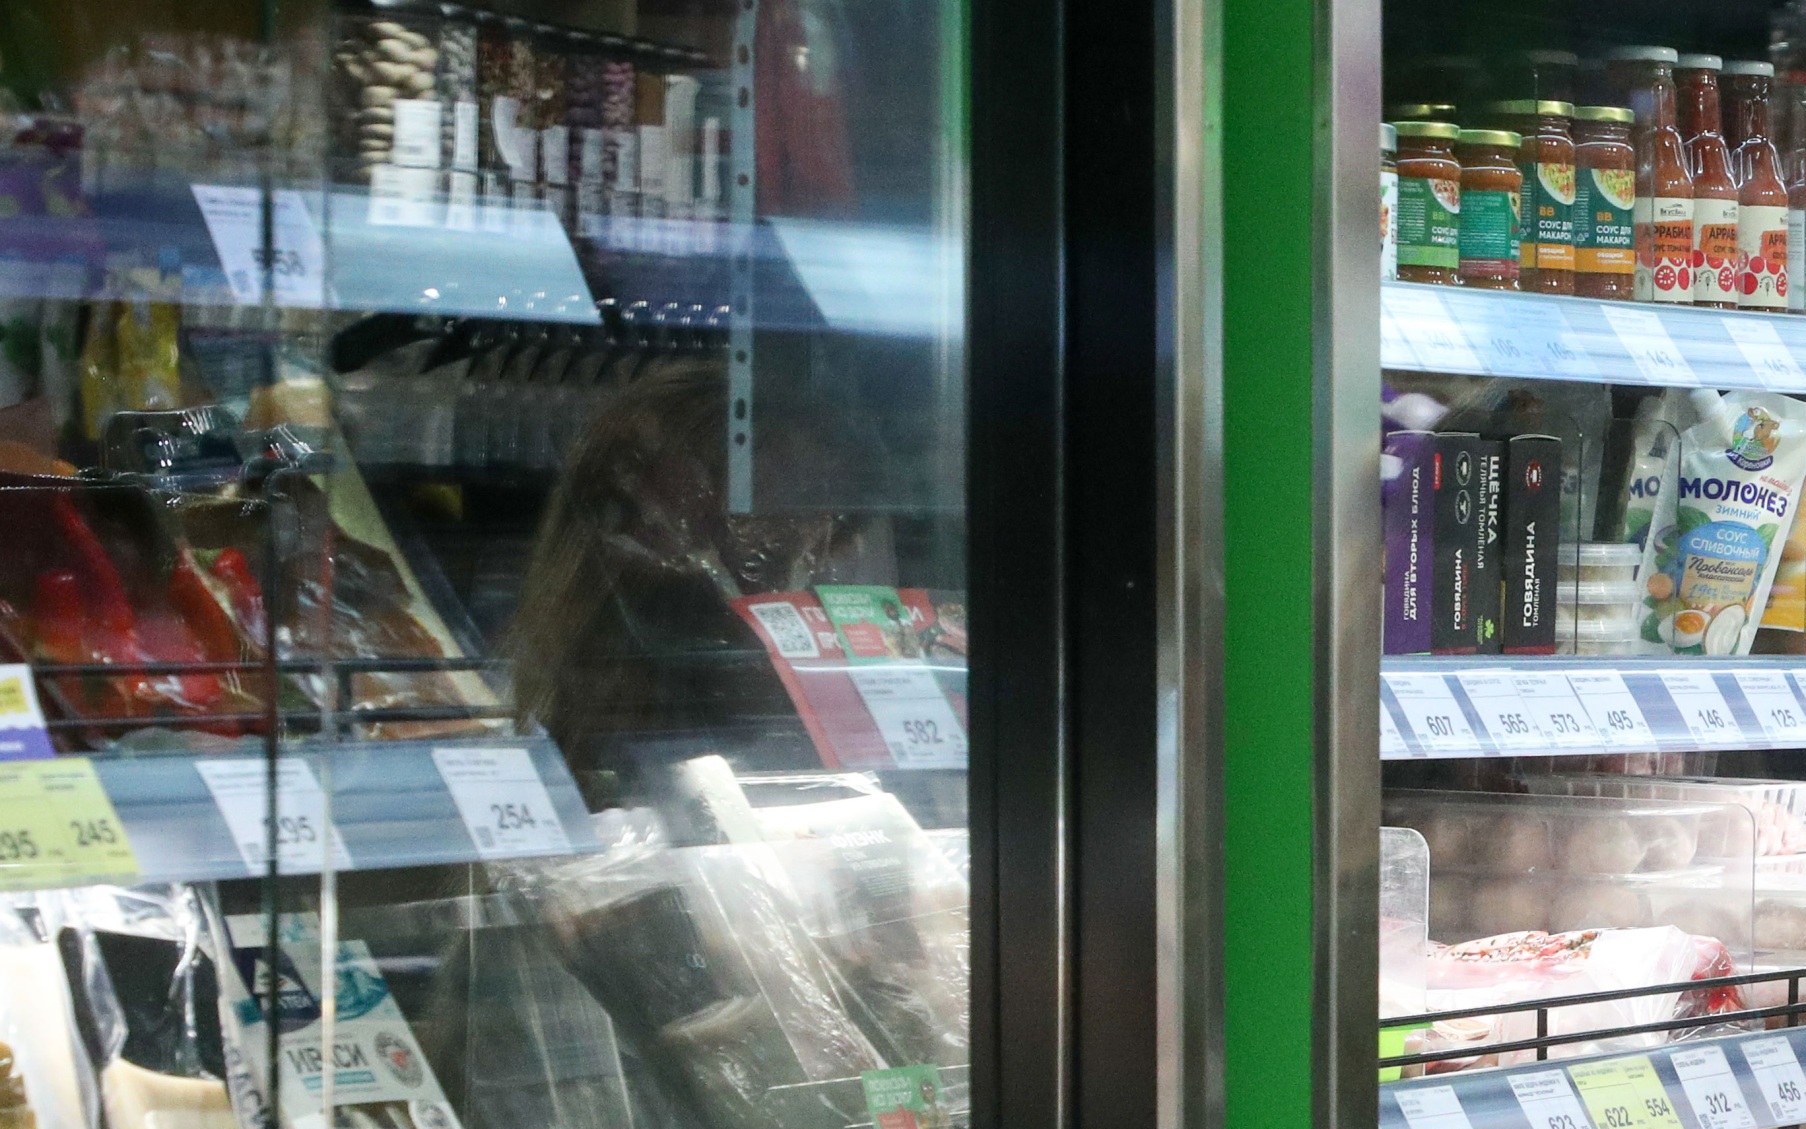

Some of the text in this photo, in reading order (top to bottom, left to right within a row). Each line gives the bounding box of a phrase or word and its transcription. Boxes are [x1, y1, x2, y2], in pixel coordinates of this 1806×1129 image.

[1538, 220, 1561, 230] СОУС
[1596, 225, 1632, 236] СОУС ДЛЯ
[1596, 235, 1631, 246] МАКАРОН
[1490, 336, 1521, 358] 106
[1546, 340, 1577, 361] 106
[1646, 347, 1678, 371] 143
[1629, 475, 1660, 499] МО
[1680, 477, 1788, 518] МОЛОНЕЗ
[1487, 455, 1500, 545] ЩЁЧКА
[1477, 455, 1489, 570] ТЕЛЯЧЬЯ ТОМЛЕНАЯ
[1715, 504, 1761, 521] ЗИМНИЙ
[1409, 466, 1421, 621] ДЛЯ ВТОРЫХ БЛЮД
[1716, 528, 1749, 545] СОУС
[1690, 537, 1760, 560] СЛИВОЧНЫЙ
[1522, 521, 1536, 628] ГОВЯДИНА
[1403, 570, 1411, 621] ГОВЯДИНА
[1454, 548, 1463, 631] ГОВЯДИНА
[1532, 577, 1541, 628] ТОМЛЕНАЯ
[1425, 714, 1455, 737] 607
[1498, 713, 1530, 735] 565
[1549, 713, 1581, 734] 573
[1606, 709, 1634, 732] 495
[1697, 708, 1725, 730] 146
[1770, 708, 1798, 729] 125
[902, 719, 945, 745] 582
[491, 803, 537, 831] 254
[69, 818, 118, 848] 245
[1777, 1080, 1801, 1103] 456
[1645, 1097, 1671, 1119] 554
[1704, 1092, 1733, 1116] 312
[1604, 1106, 1634, 1129] 622
